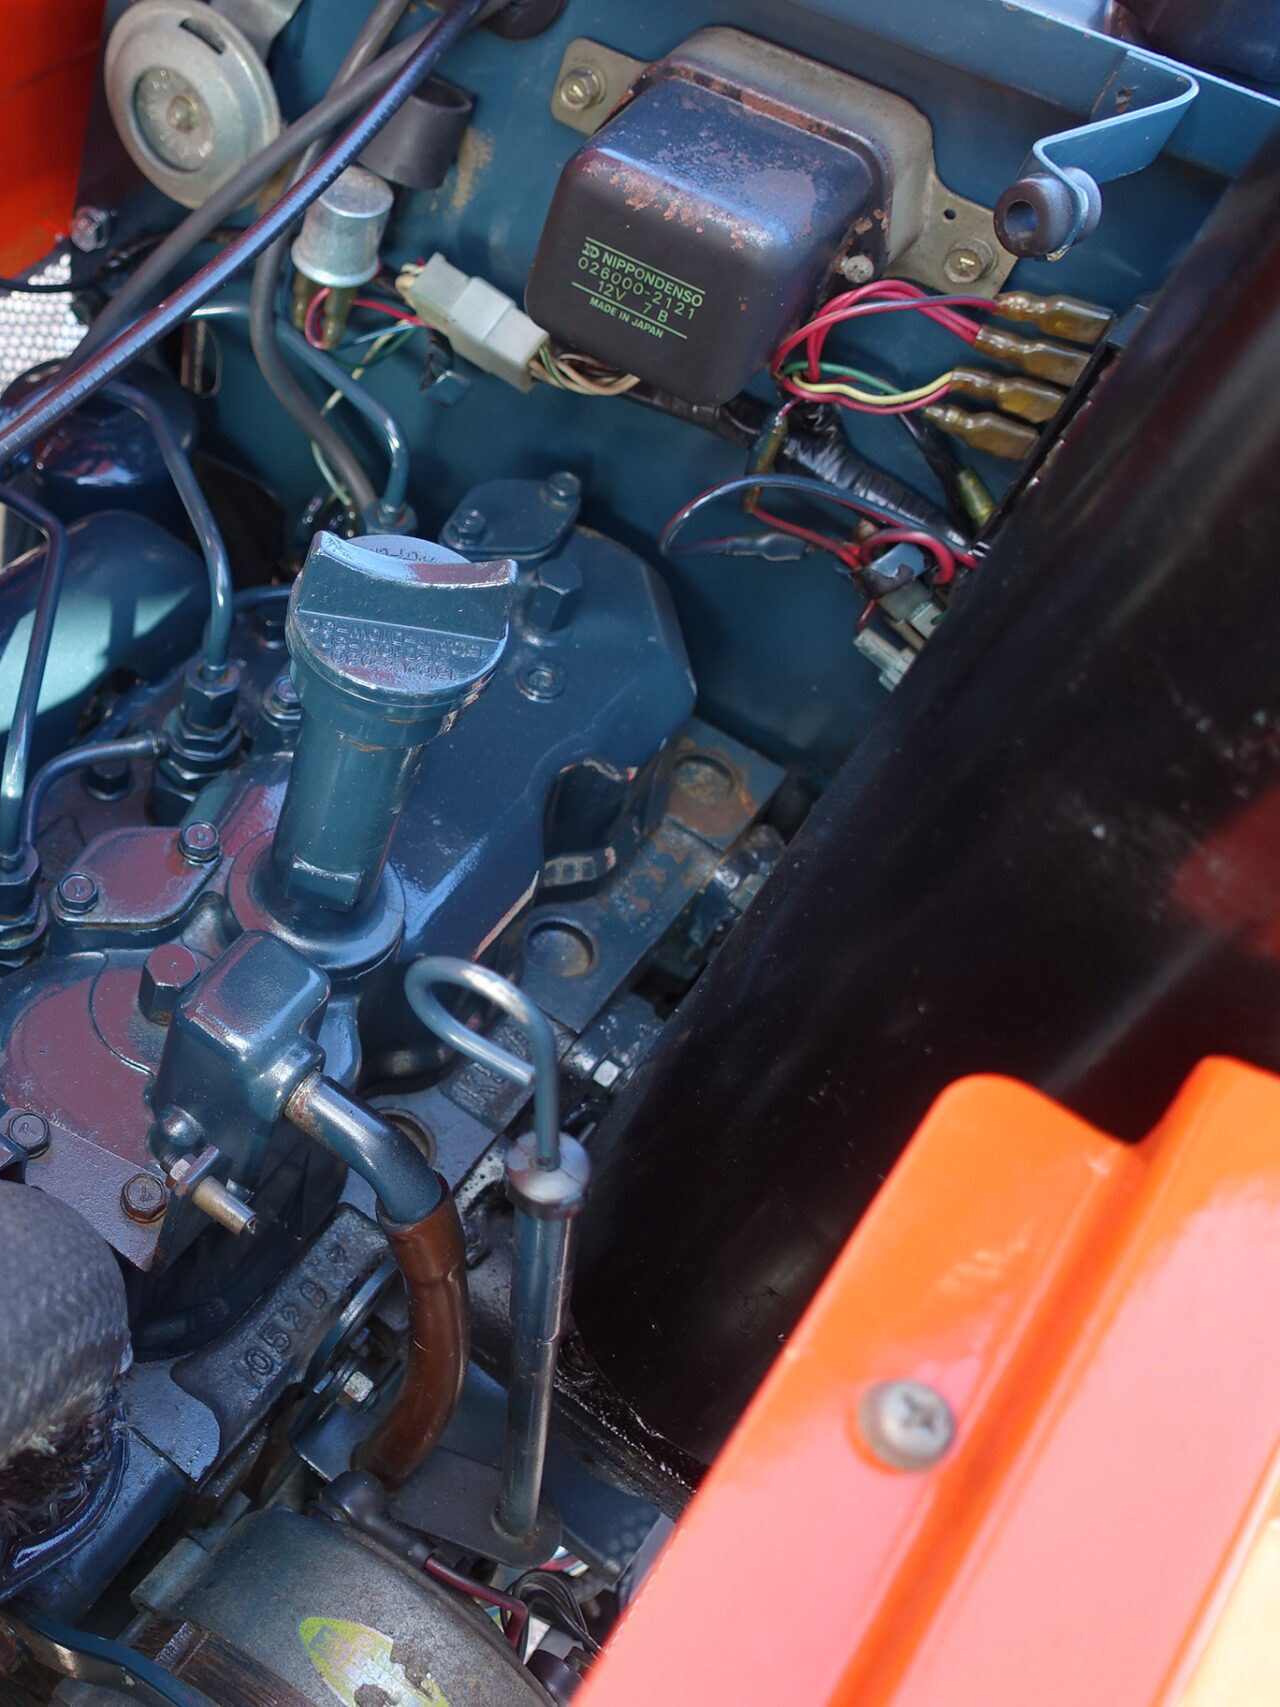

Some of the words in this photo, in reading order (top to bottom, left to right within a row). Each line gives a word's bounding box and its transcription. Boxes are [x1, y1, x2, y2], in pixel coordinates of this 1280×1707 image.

[578, 257, 695, 320] 026000-2121
[598, 281, 626, 301] 12V
[602, 251, 703, 307] NIPPONDENSO
[589, 297, 617, 317] MADE
[618, 310, 630, 322] IN
[631, 319, 664, 338] JAPAN
